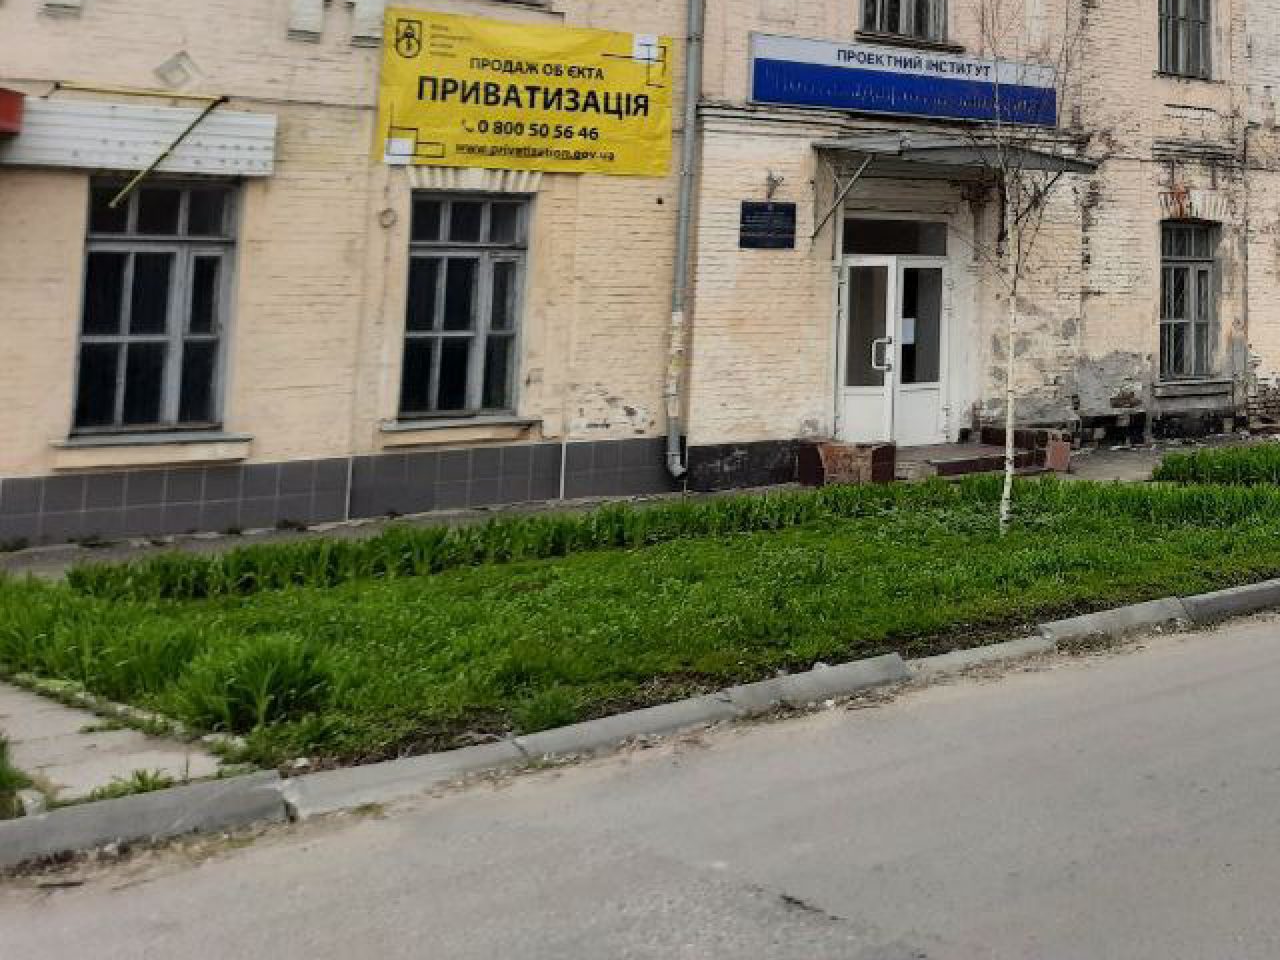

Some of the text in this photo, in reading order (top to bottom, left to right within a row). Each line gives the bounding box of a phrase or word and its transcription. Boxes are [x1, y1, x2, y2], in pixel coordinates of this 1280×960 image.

[469, 57, 539, 75] ПРОДАЖ
[837, 49, 991, 77] ПРОЕКТНИЙ ІНСТИТУТ
[417, 75, 649, 120] ПРИВАТИЗАЦІЯ
[477, 119, 599, 141] 0 800 50 56 46
